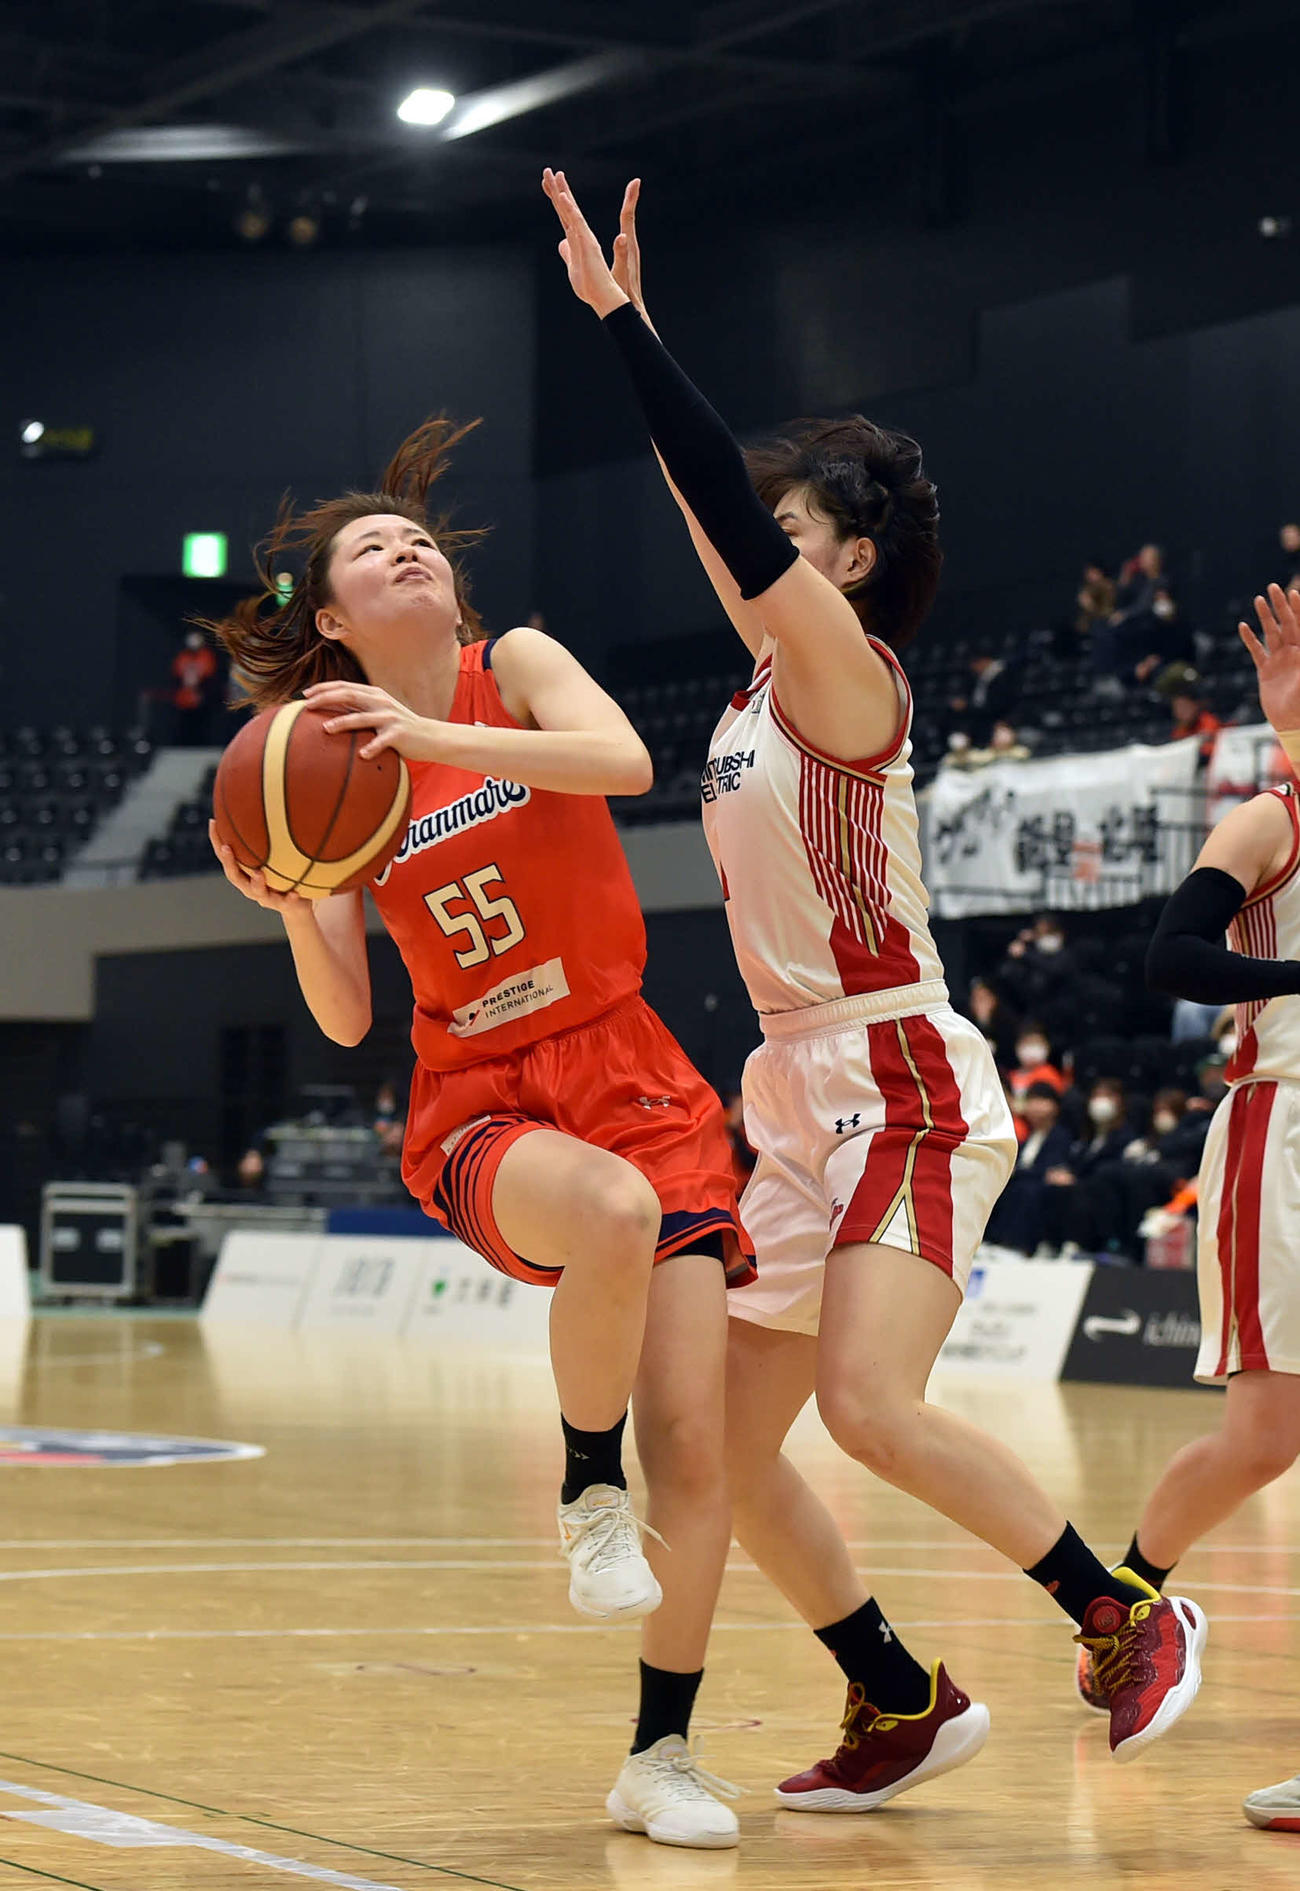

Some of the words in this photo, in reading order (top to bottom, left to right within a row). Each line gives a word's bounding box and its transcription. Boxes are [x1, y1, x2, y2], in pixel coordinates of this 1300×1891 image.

[386, 776, 528, 867] ranmare
[423, 863, 526, 970] 55
[482, 980, 535, 1008] PRESTIGE
[485, 985, 553, 1018] INTERNATIONAL
